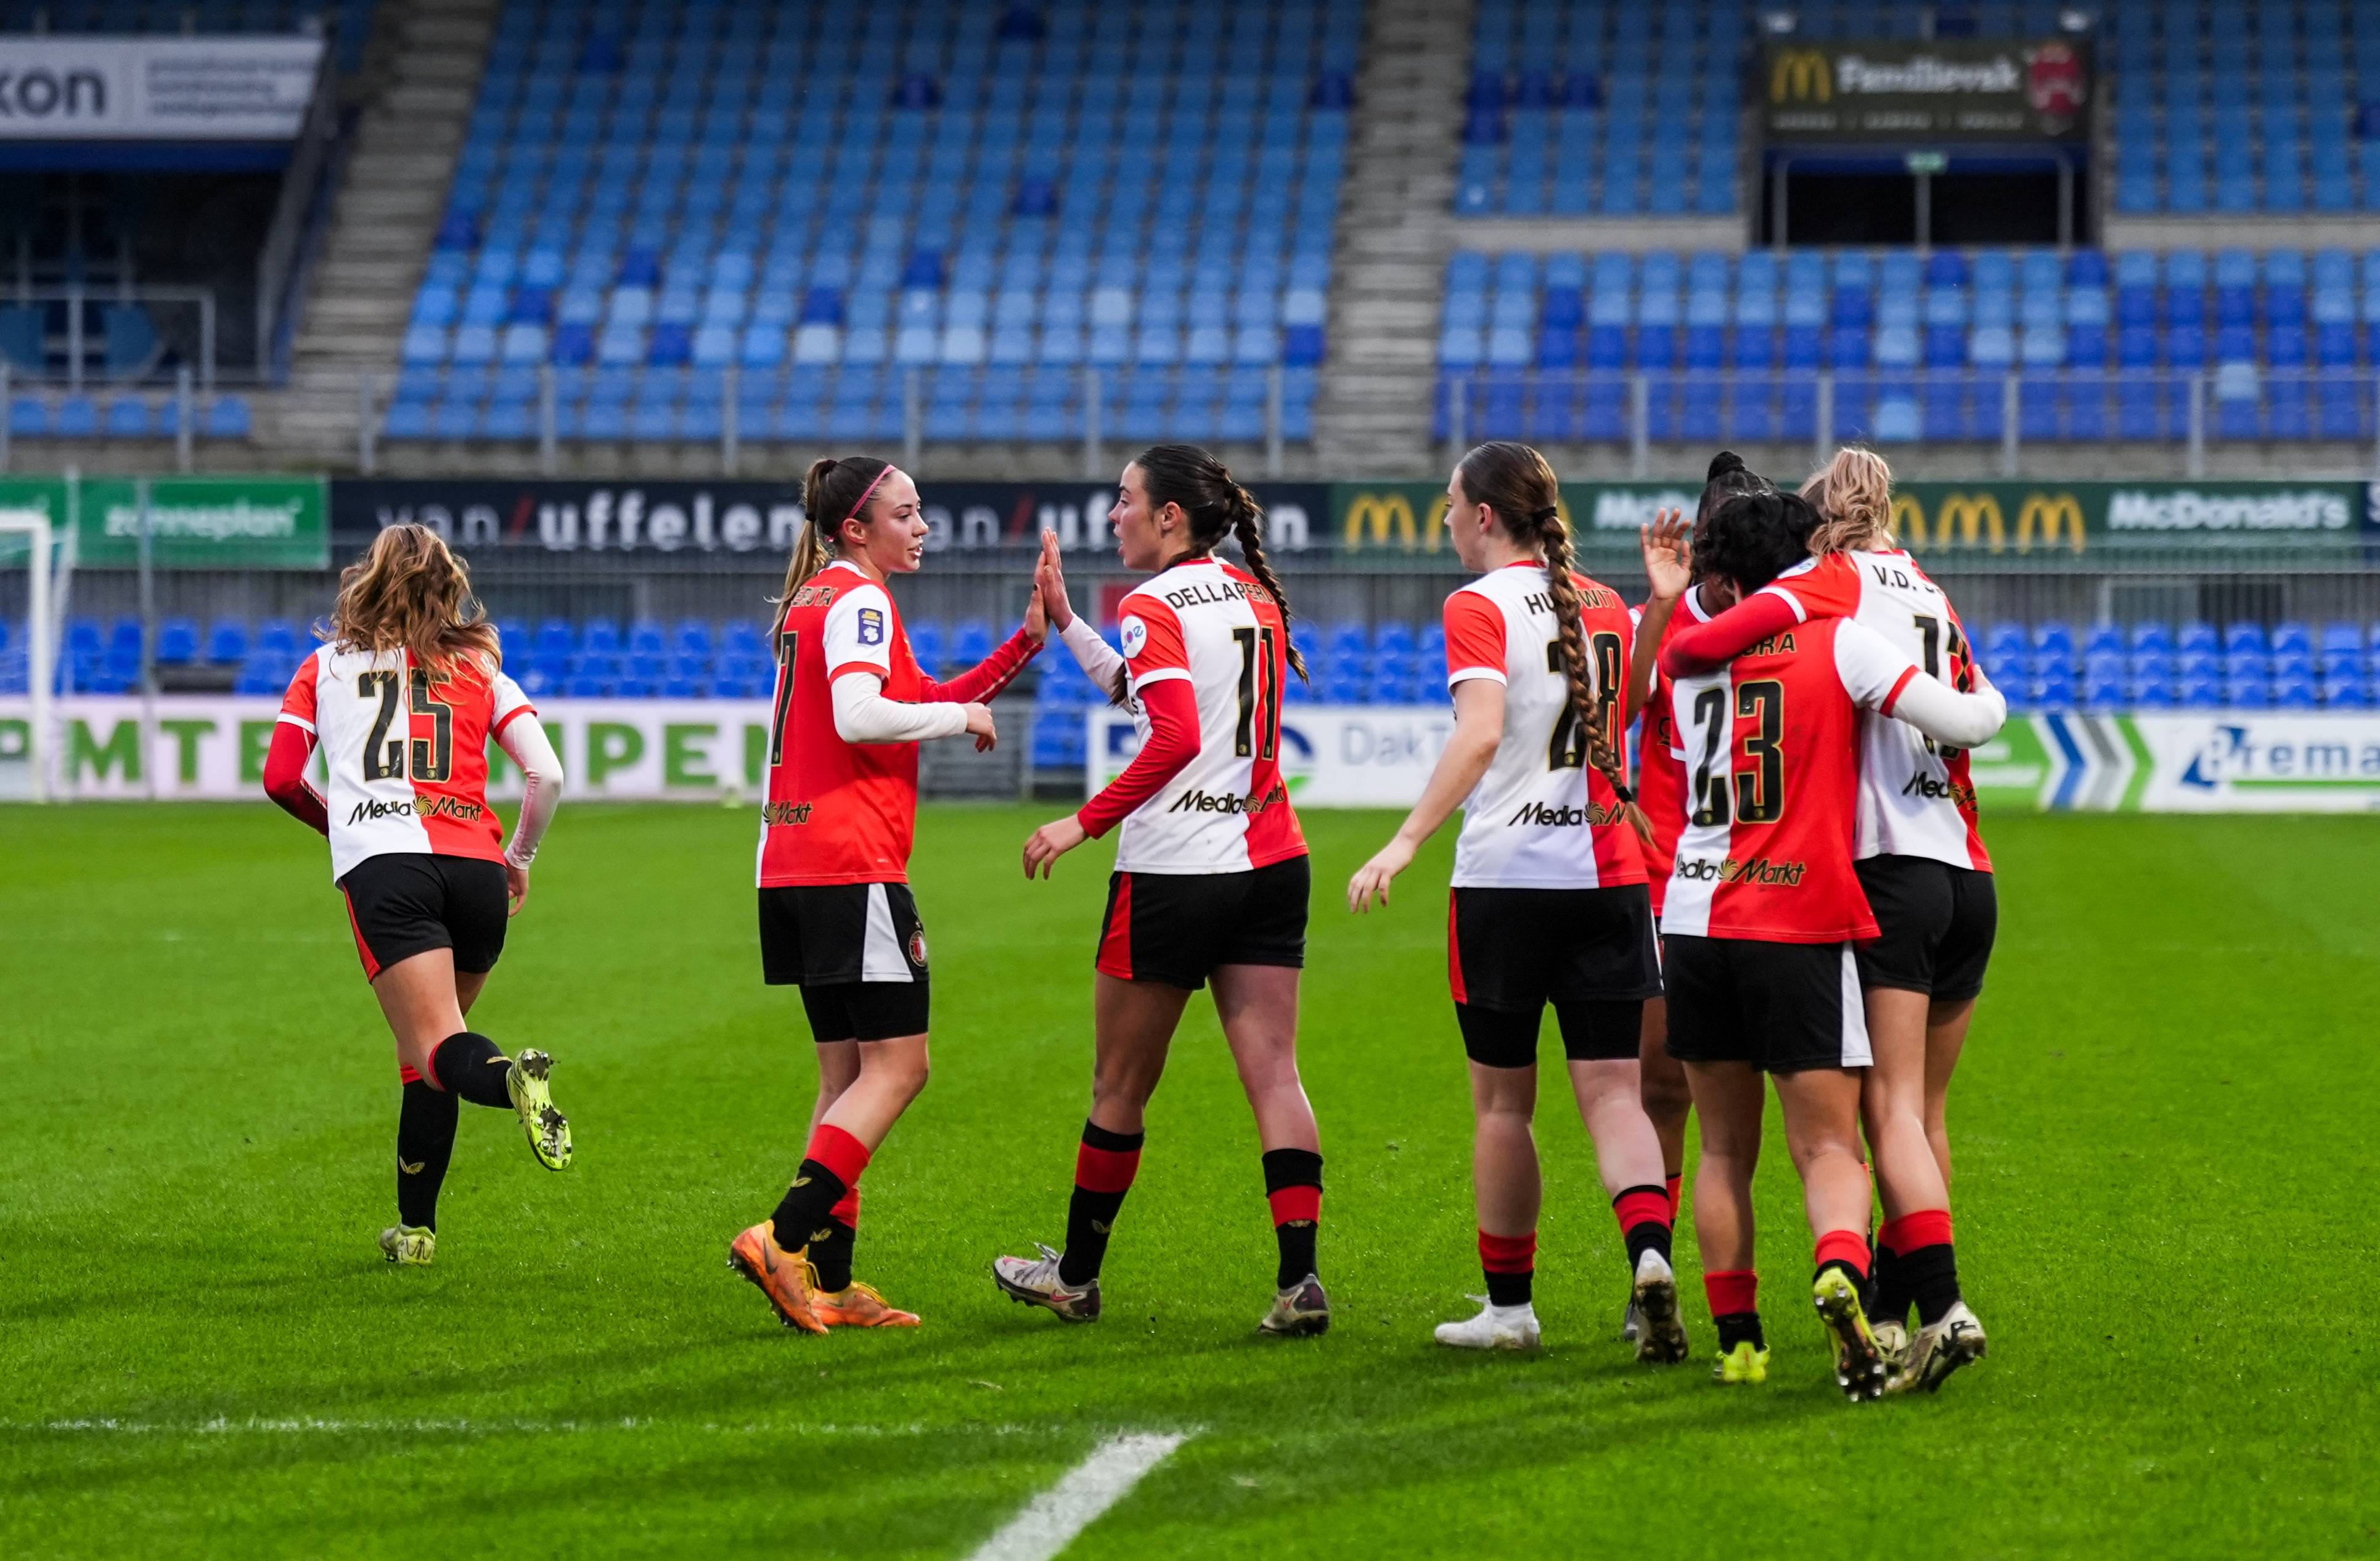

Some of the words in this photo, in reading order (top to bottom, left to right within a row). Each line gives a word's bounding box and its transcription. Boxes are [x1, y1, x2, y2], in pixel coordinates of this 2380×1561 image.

[2108, 491, 2350, 530] McDonald's
[1164, 582, 1275, 609] DELLAPERU
[1232, 626, 1278, 761] 11
[1547, 631, 1624, 773] 28
[358, 670, 453, 783] 25
[1692, 679, 1785, 828] 23
[346, 799, 411, 826] Media
[431, 795, 483, 823] Markt
[1168, 789, 1244, 815] Media
[1507, 802, 1582, 827] Media
[1729, 858, 1806, 887] Markt
